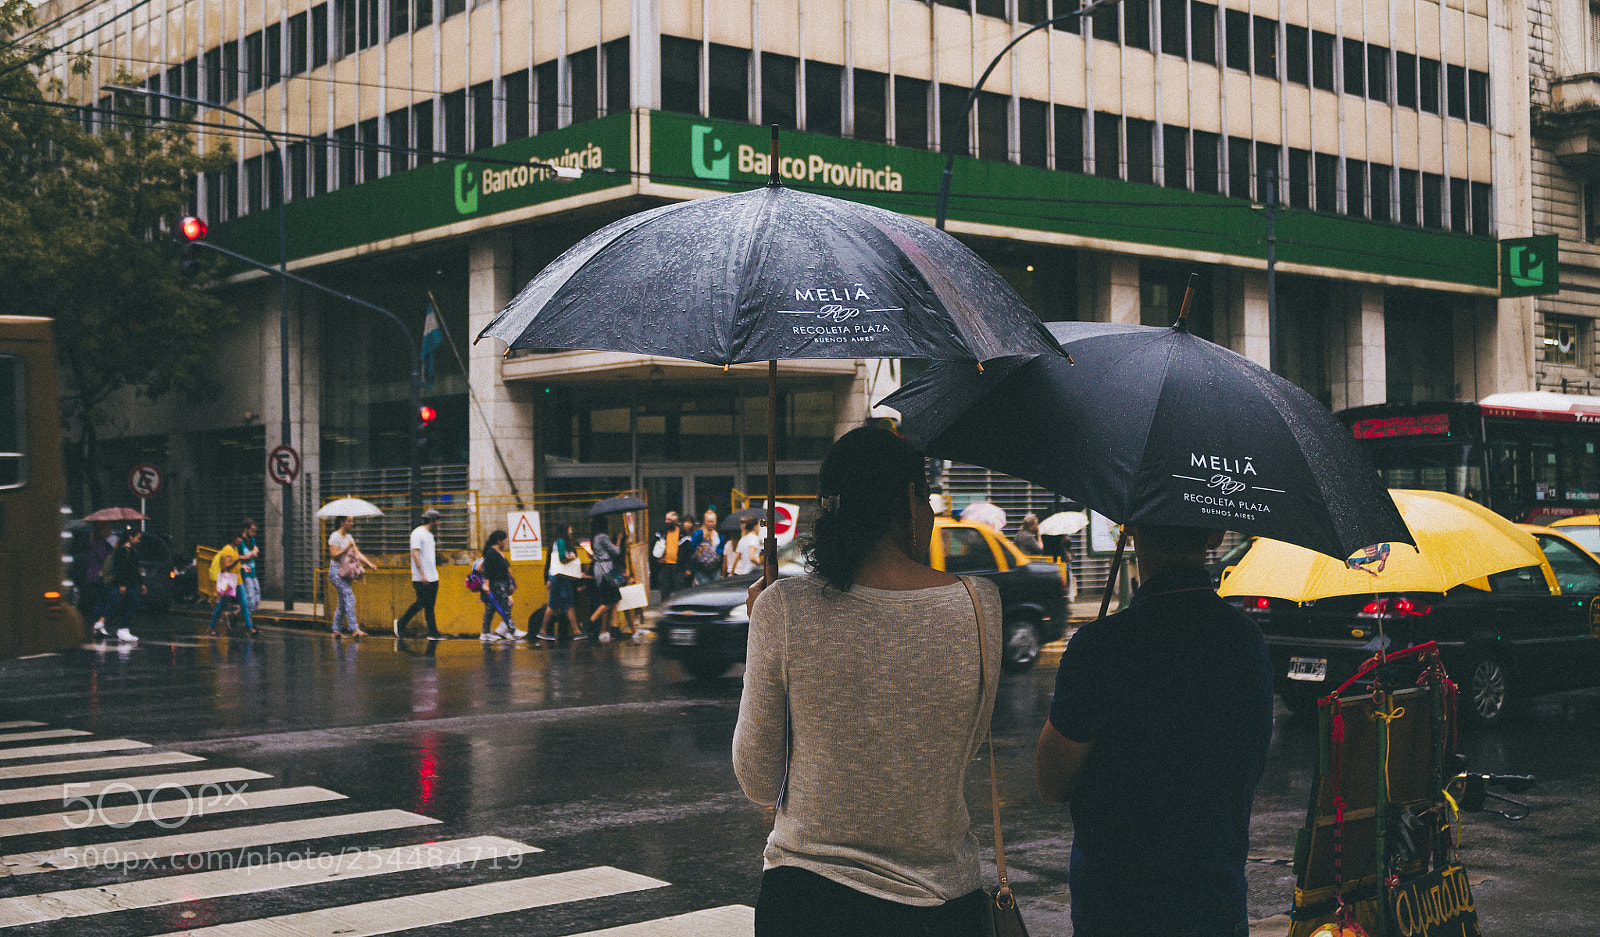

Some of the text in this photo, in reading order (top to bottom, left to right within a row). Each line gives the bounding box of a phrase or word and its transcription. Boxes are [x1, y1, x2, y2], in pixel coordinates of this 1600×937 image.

[482, 165, 529, 195] Banco
[808, 154, 903, 192] Provincia
[792, 324, 891, 336] RECOLETA PLAZA
[1352, 419, 1385, 439] 12
[1183, 492, 1271, 513] RECOLETA PLAZA
[1201, 507, 1256, 521] BUENOS AIRES
